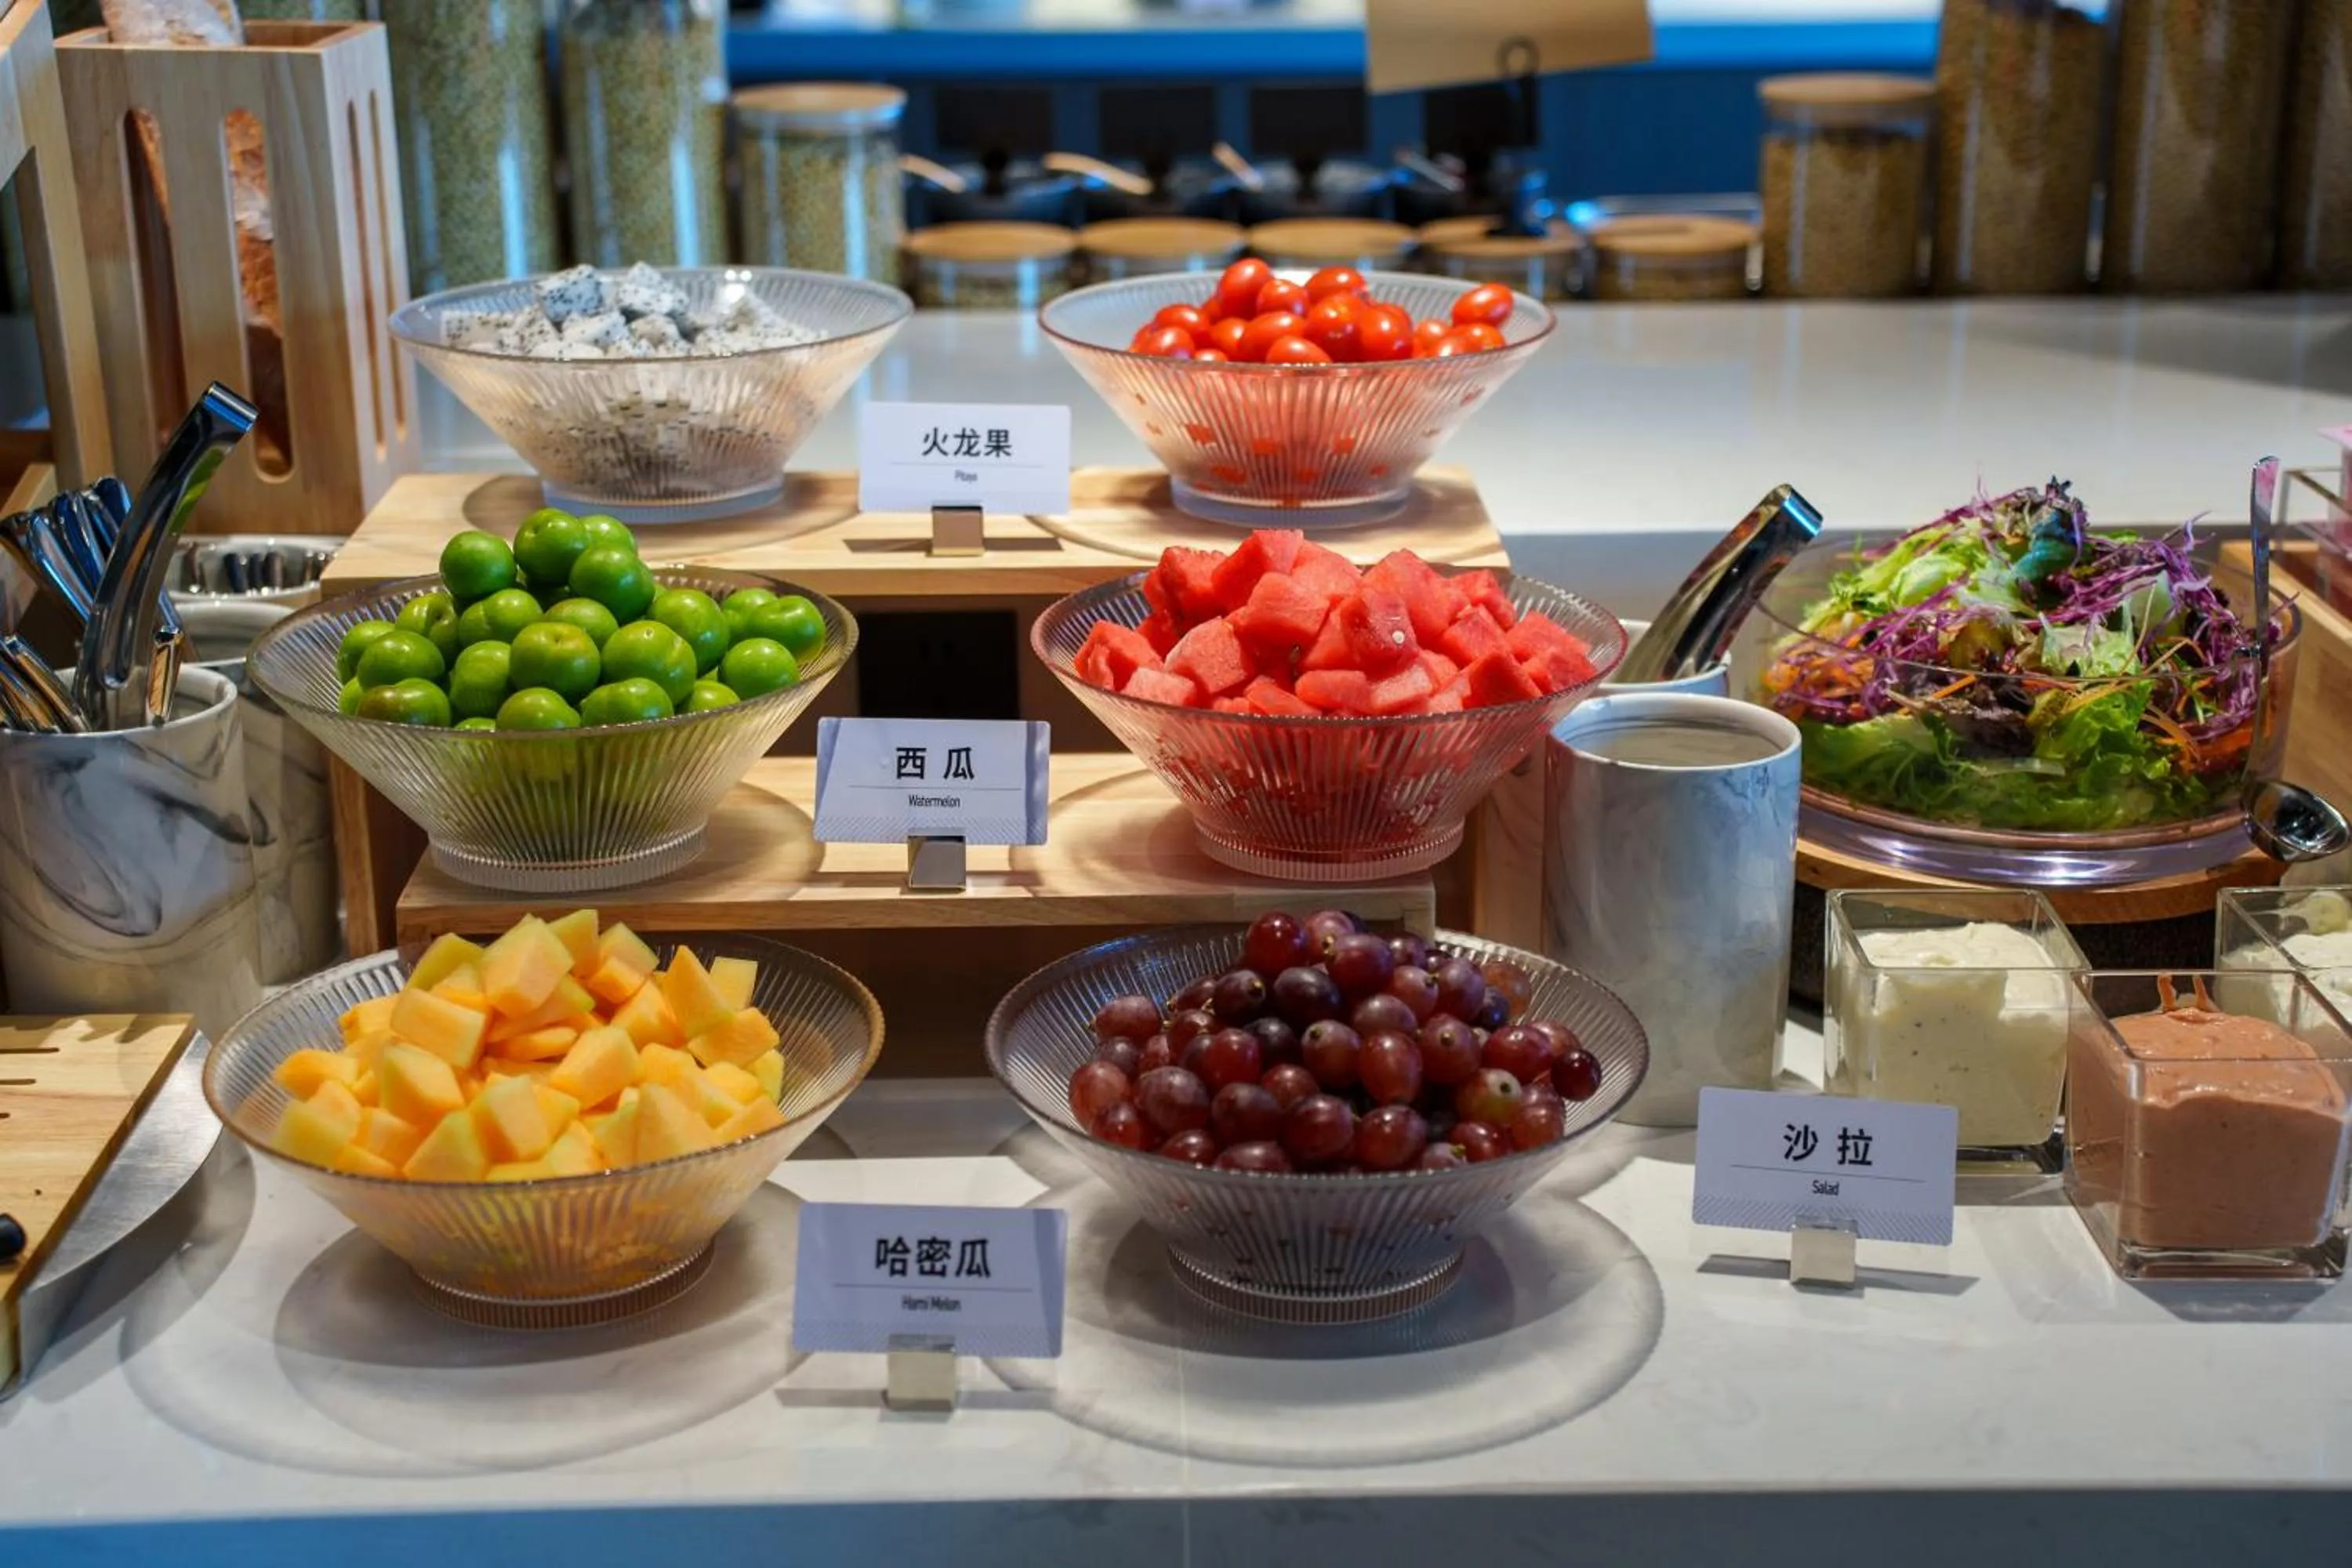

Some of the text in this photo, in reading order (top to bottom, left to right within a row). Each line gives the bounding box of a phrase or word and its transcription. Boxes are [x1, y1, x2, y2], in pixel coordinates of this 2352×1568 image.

[921, 427, 1011, 457] 火龙果
[895, 747, 975, 779] 西瓜
[909, 794, 960, 808] Watermelon
[1783, 1123, 1873, 1166] 沙拉
[1812, 1180, 1839, 1196] Salad
[875, 1236, 991, 1277] 哈密瓜
